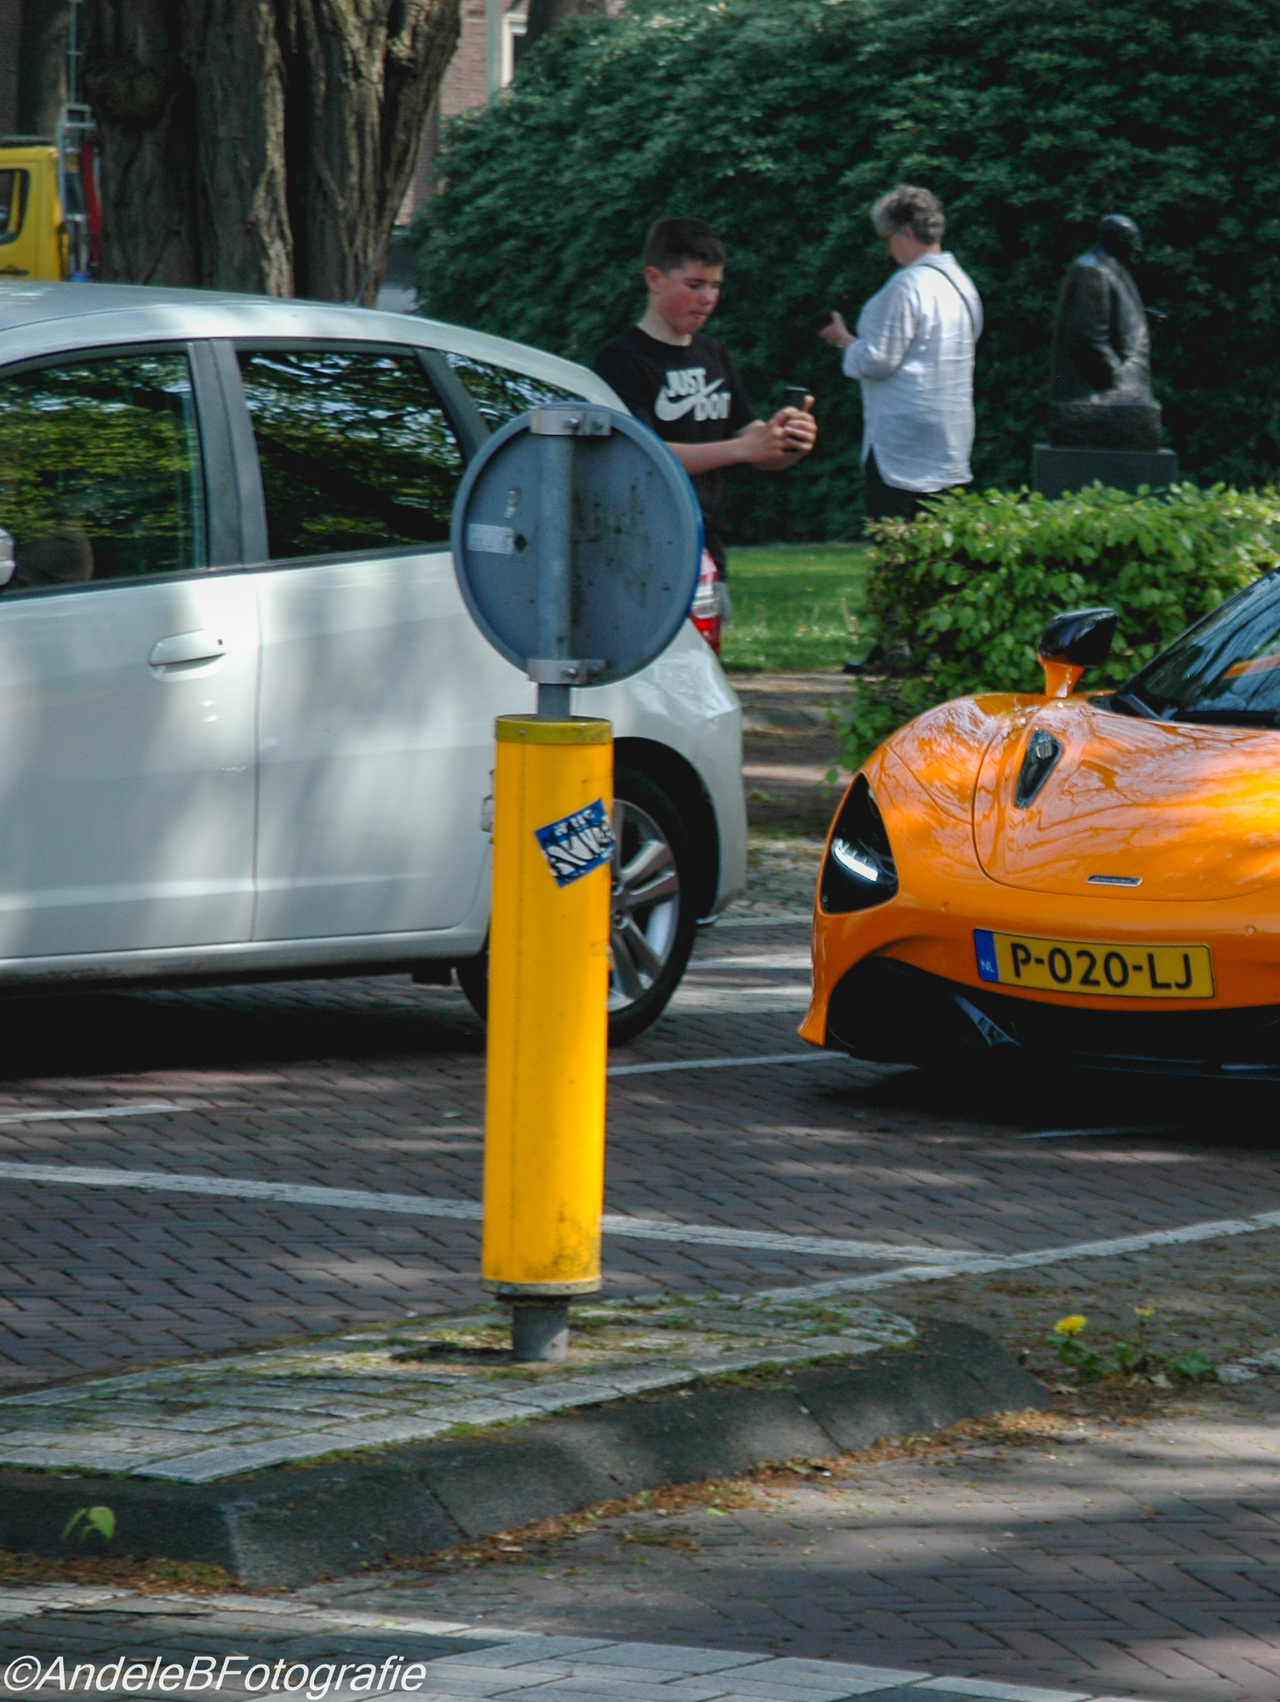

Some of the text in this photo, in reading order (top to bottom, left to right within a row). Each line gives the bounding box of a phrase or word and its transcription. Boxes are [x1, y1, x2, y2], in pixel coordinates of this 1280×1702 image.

[665, 367, 707, 397] JUST
[981, 960, 995, 973] NL
[1011, 942, 1193, 989] P-020-LJ
